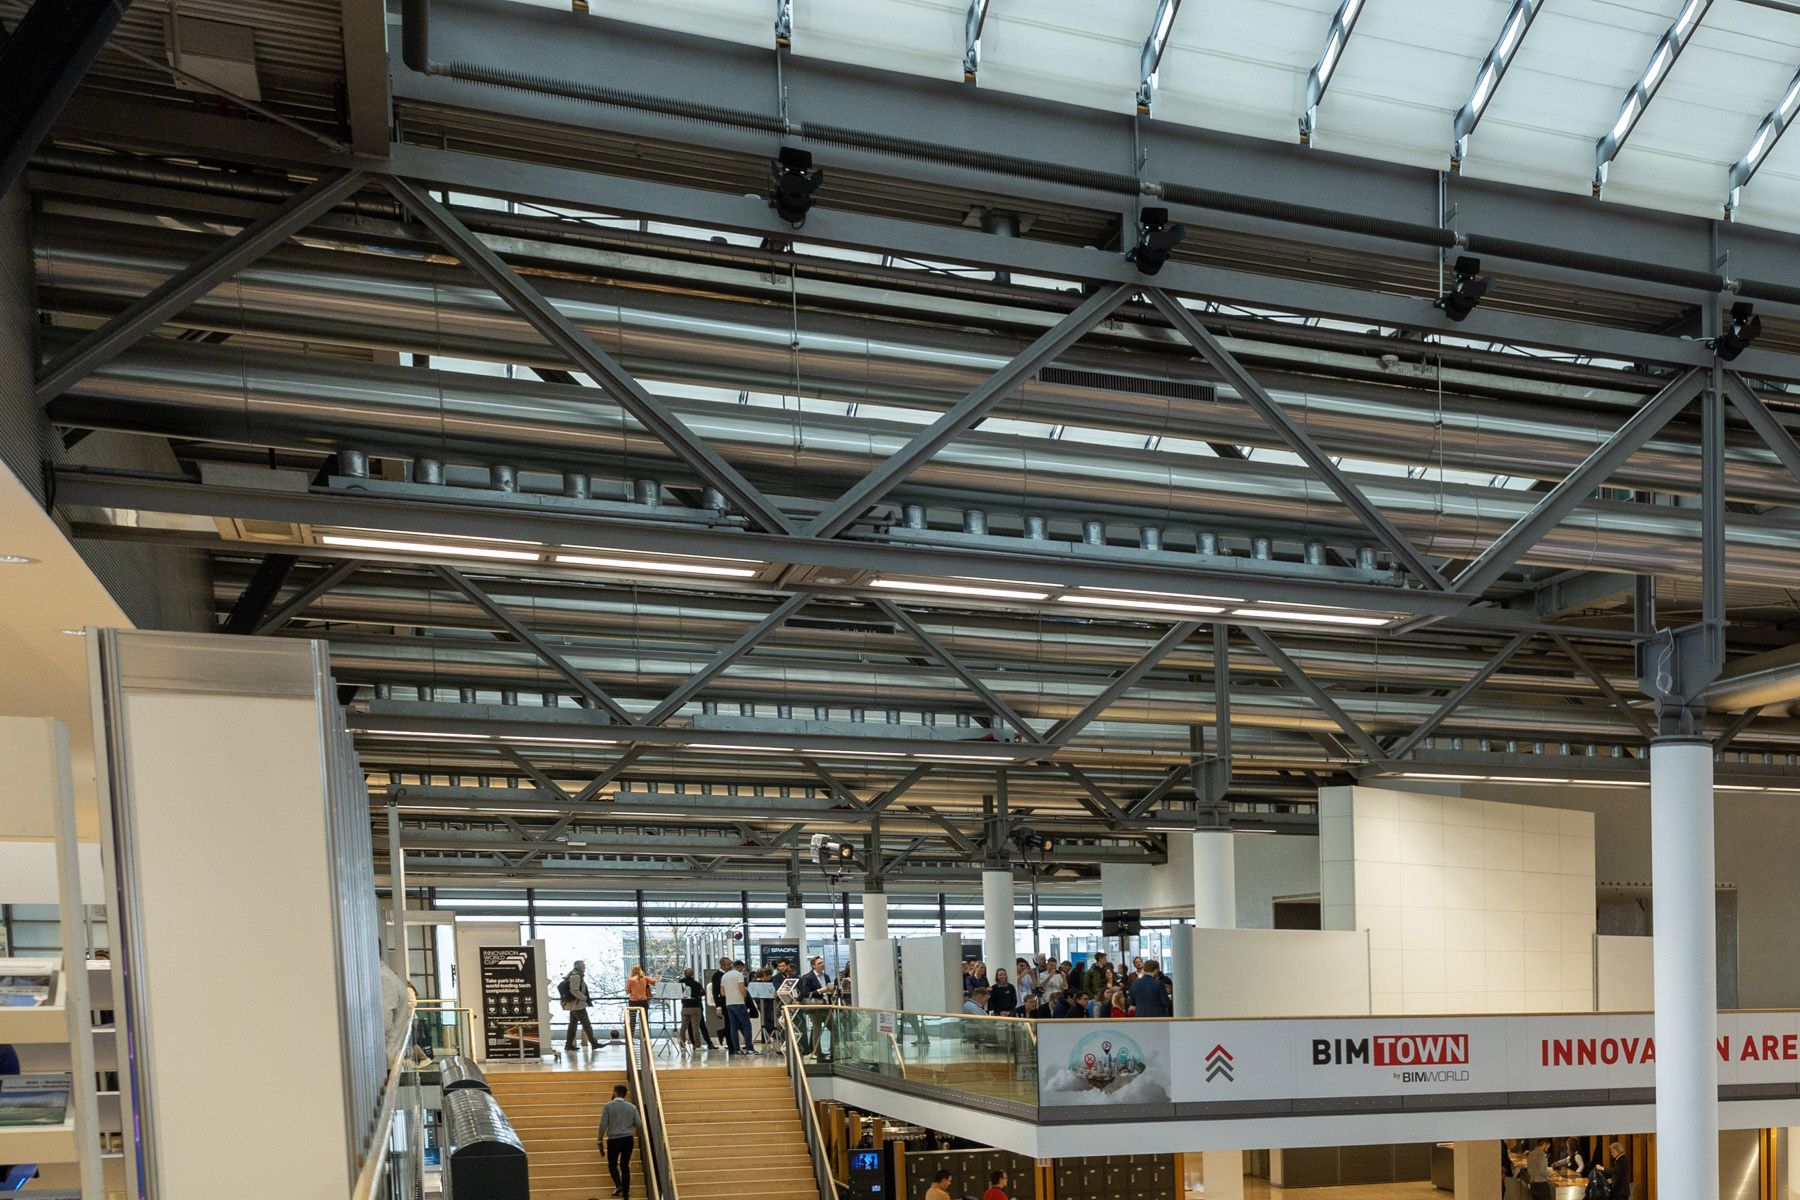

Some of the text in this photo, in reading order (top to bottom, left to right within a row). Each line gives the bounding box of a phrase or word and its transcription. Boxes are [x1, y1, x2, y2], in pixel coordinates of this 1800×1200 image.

[1542, 1035, 1730, 1066] INNOVAN
[1393, 1070, 1470, 1082] by BIMWORLD
